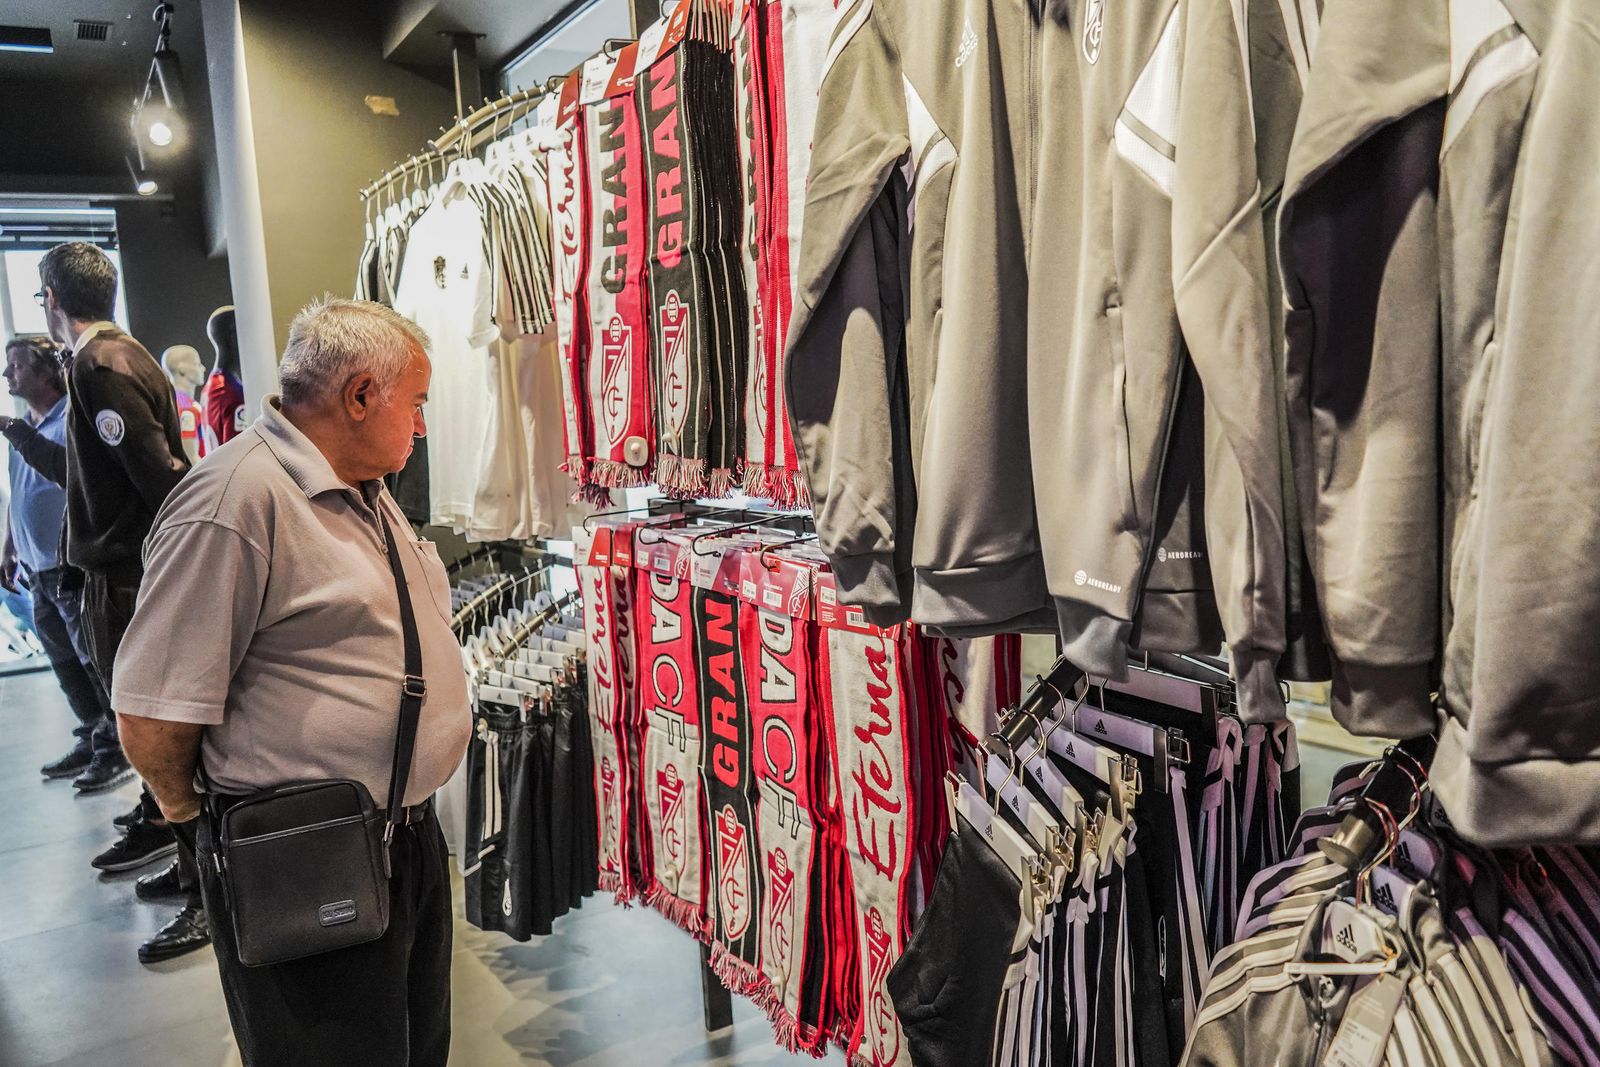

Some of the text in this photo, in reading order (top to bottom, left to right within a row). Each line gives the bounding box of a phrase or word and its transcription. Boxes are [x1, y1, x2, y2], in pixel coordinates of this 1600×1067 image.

[599, 104, 628, 294] GRAN
[650, 53, 684, 269] GRAN
[593, 566, 612, 735] Eterna
[1087, 577, 1122, 594] AEROREADY
[704, 598, 740, 789] GRAN
[851, 635, 902, 882] Eterna
